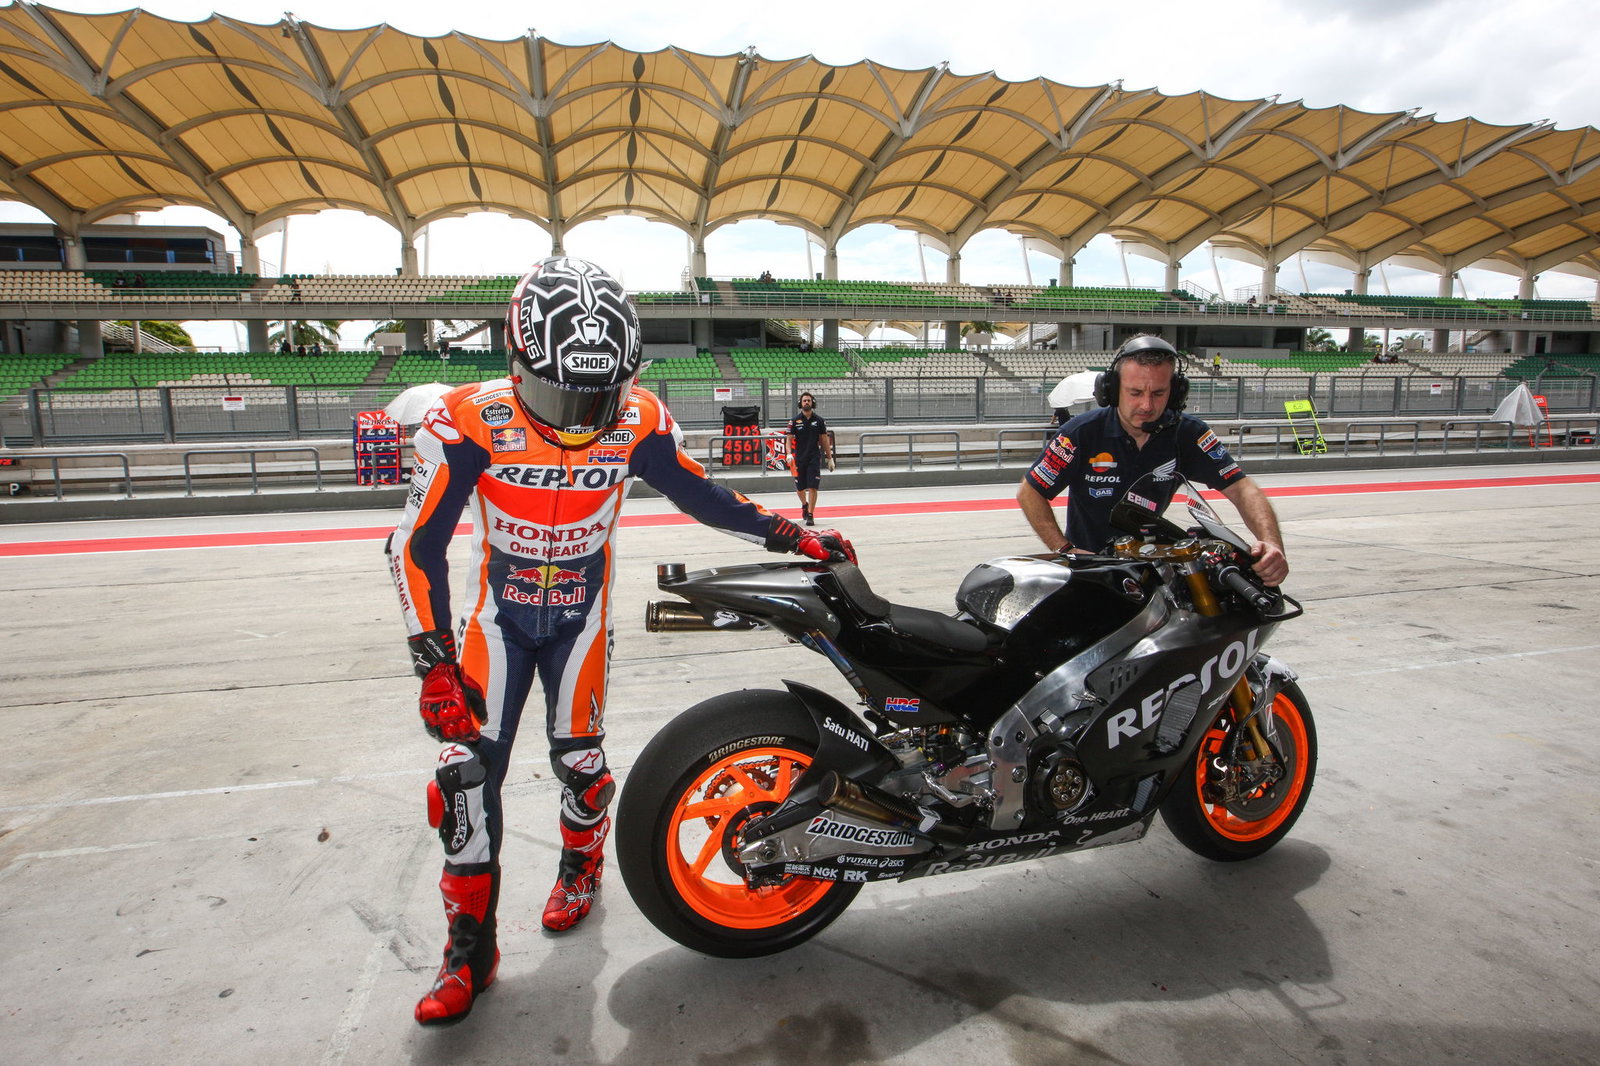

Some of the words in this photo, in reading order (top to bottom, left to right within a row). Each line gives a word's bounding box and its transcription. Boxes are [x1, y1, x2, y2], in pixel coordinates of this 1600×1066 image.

[520, 295, 540, 360] LOTUS
[571, 356, 610, 370] SHOEI
[577, 385, 600, 393] YOU
[485, 407, 510, 416] Estrella
[486, 413, 510, 422] Galicia
[601, 432, 630, 443] SHOEI
[588, 449, 628, 463] HRC
[495, 466, 619, 489] REPSOL
[1085, 474, 1121, 483] REPSOL
[10, 483, 19, 496] P
[1095, 489, 1113, 497] GAS
[494, 517, 607, 543] HONDA
[509, 541, 539, 555] One
[502, 584, 543, 606] Red
[547, 586, 586, 606] Bull
[885, 697, 920, 712] HRC
[823, 716, 845, 738] Satu
[846, 729, 870, 752] HATI
[708, 735, 786, 764] BRIDGESTONE
[1063, 815, 1088, 825] One
[807, 816, 916, 847] BRIDGESTONE
[965, 829, 1060, 852] HONDA
[846, 856, 879, 866] YUTAKA
[813, 866, 839, 878] NGK
[843, 869, 869, 882] RK
